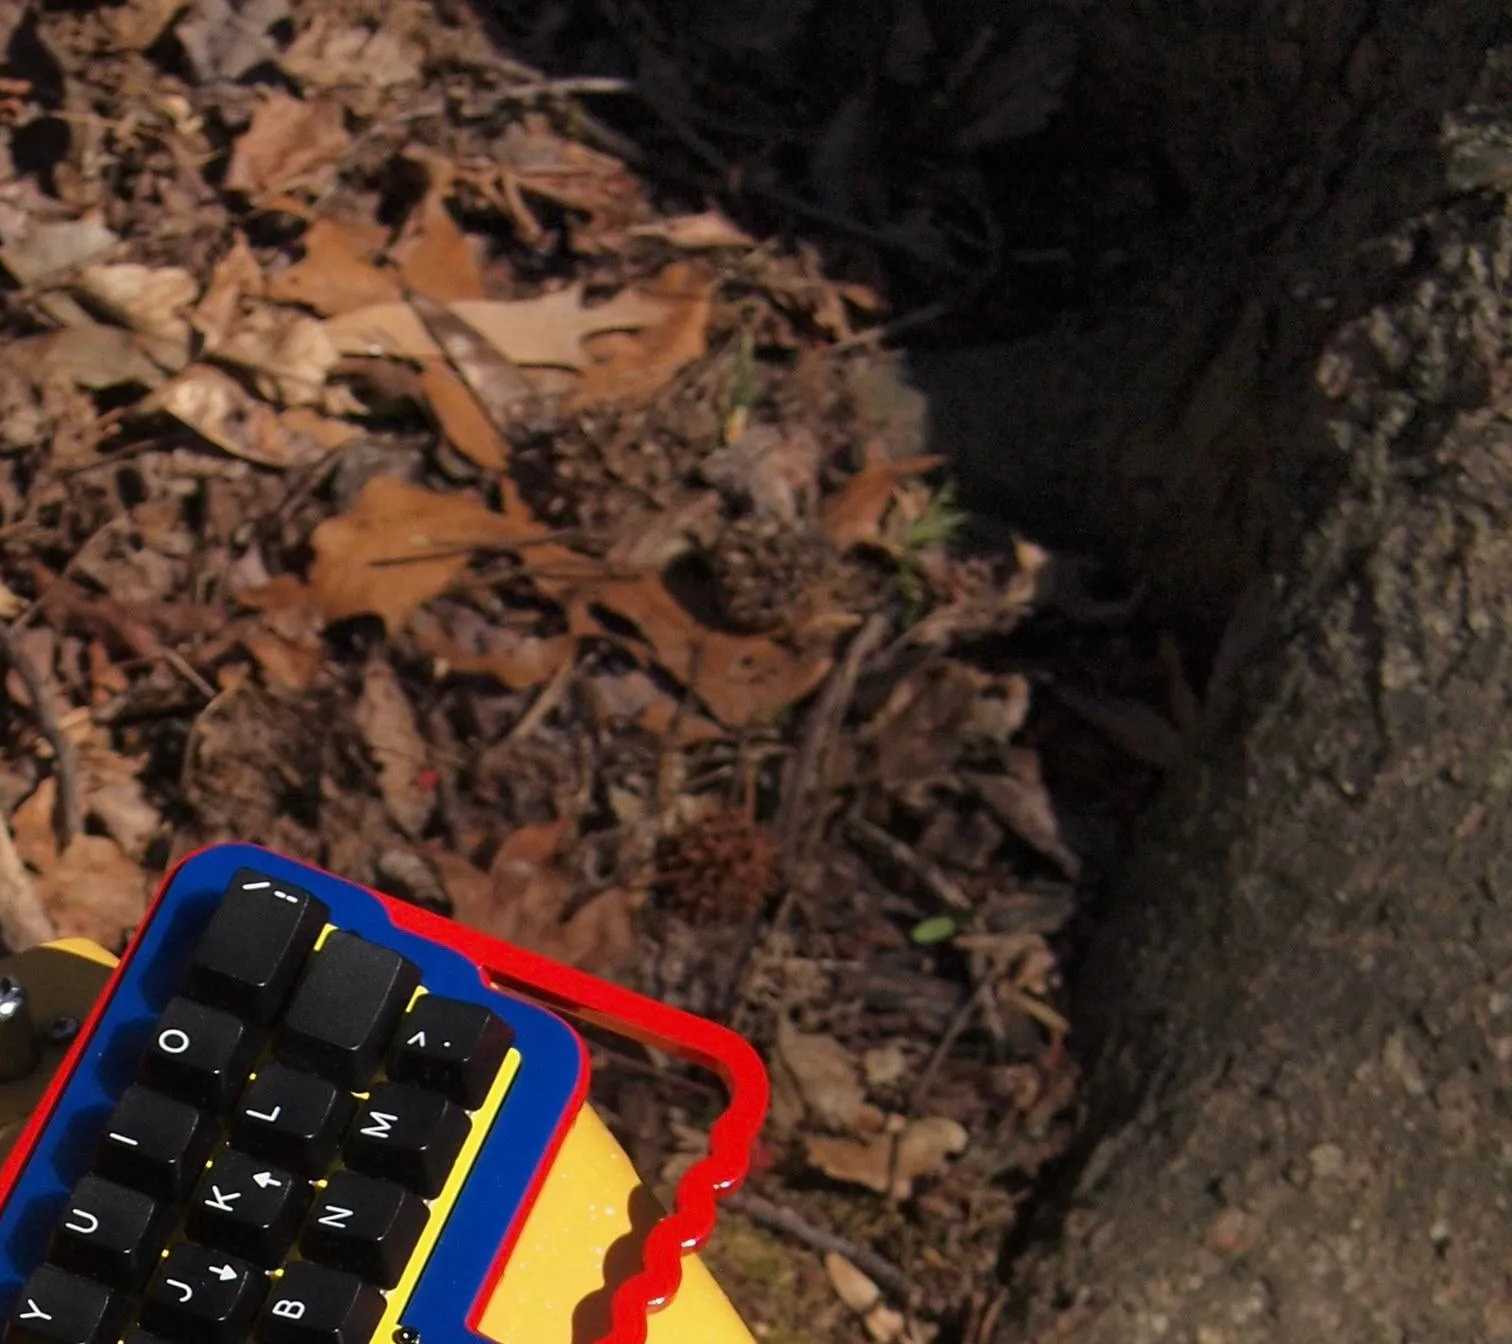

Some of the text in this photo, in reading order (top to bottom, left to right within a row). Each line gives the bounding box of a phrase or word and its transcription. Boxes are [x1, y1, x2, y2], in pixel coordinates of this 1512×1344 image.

[158, 1029, 190, 1054] O
[246, 1106, 281, 1122] L
[360, 1111, 398, 1138] M
[204, 1185, 241, 1212] K
[65, 1208, 99, 1234] U
[166, 1278, 193, 1302] J
[19, 1299, 52, 1321] Y
[272, 1299, 305, 1319] B
